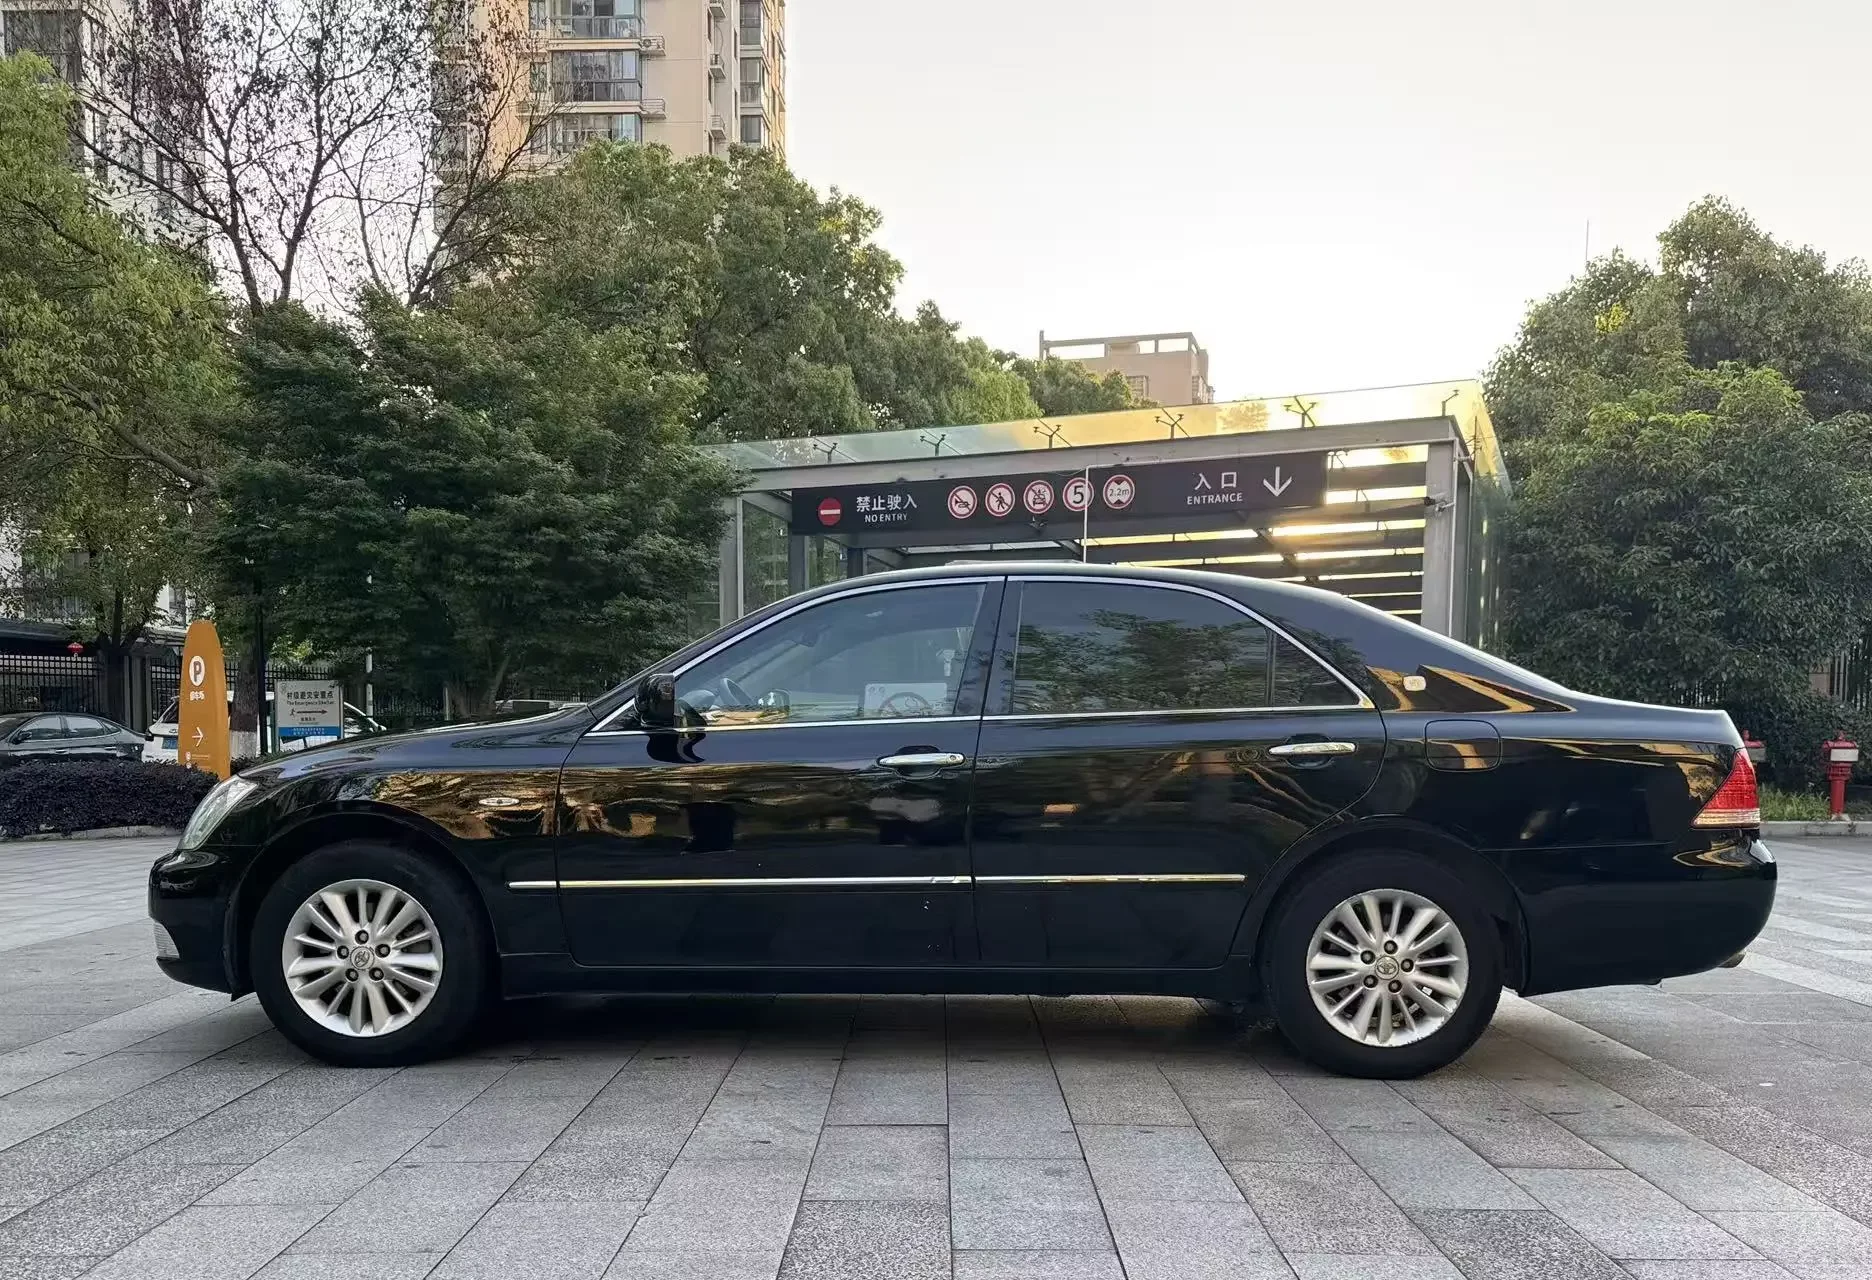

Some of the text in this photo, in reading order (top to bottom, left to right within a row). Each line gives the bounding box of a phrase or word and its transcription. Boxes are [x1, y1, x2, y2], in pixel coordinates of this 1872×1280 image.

[1194, 471, 1237, 491] 入口
[1073, 485, 1084, 504] 5
[1109, 488, 1130, 497] 2.2m
[1187, 492, 1244, 505] ENTRANCE
[856, 494, 917, 512] 禁止驶入
[865, 513, 908, 523] NO ENTRY
[193, 661, 202, 682] P
